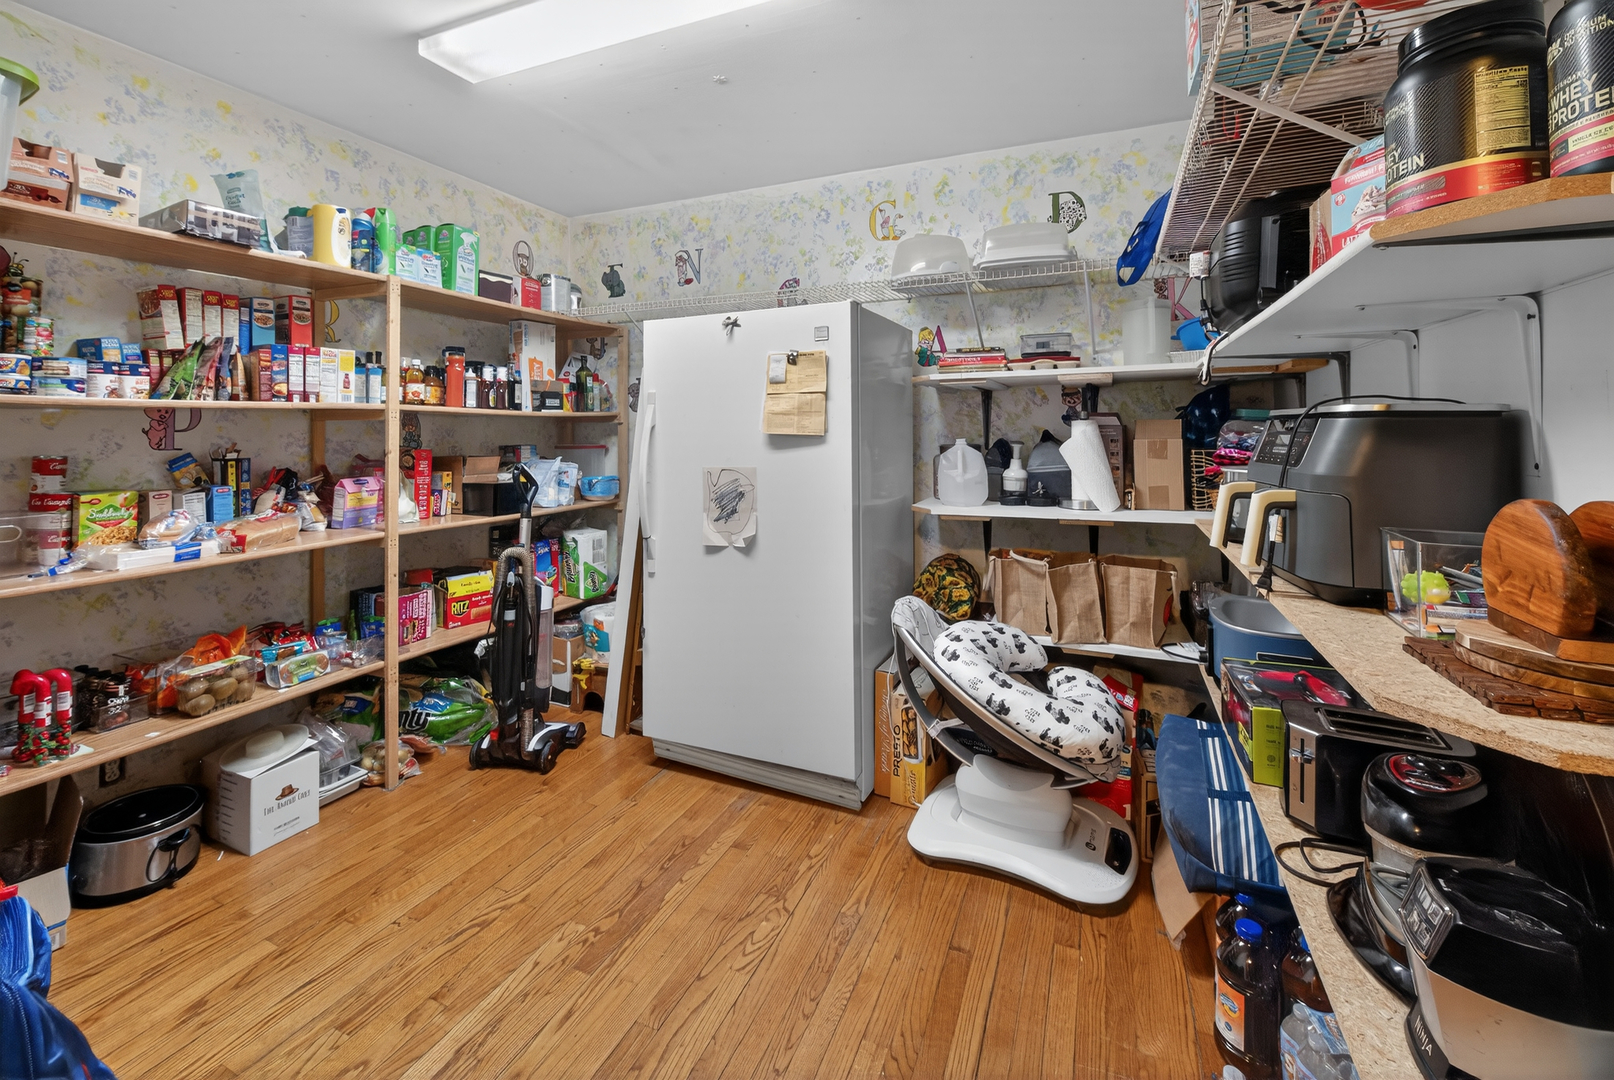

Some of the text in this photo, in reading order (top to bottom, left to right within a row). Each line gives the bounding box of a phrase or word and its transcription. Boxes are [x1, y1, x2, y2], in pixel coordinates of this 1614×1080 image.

[1550, 72, 1599, 113] WHEY
[451, 600, 470, 616] RITZ
[893, 724, 903, 777] PRESTO
[1413, 1014, 1434, 1057] NINJA
